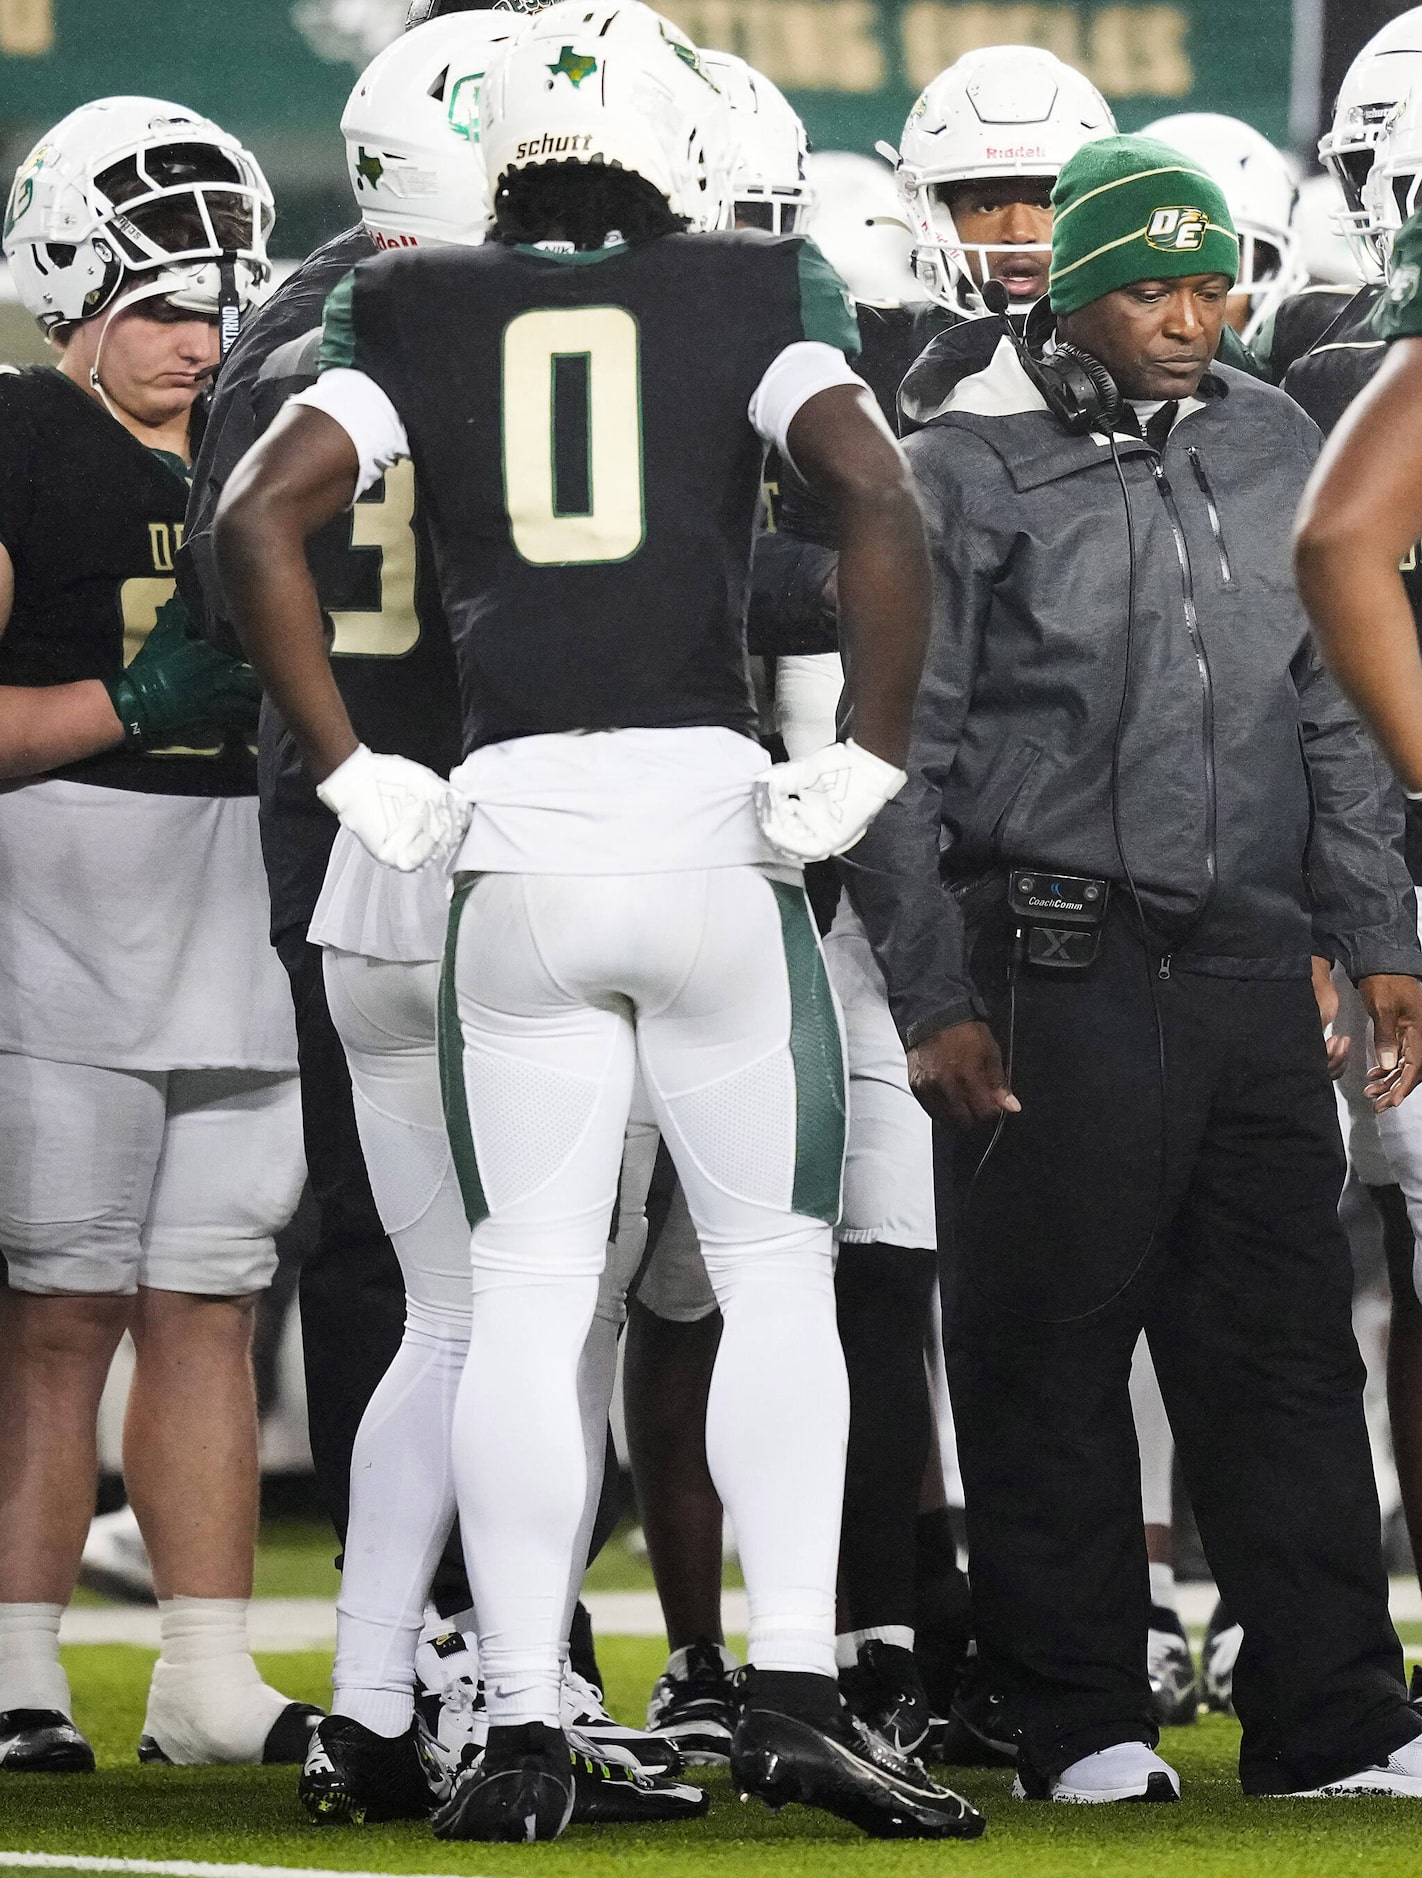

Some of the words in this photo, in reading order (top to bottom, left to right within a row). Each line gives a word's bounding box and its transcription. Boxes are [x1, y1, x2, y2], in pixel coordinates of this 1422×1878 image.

[516, 132, 593, 159] schutt
[502, 305, 645, 566] 0
[1028, 896, 1083, 911] CoachComm
